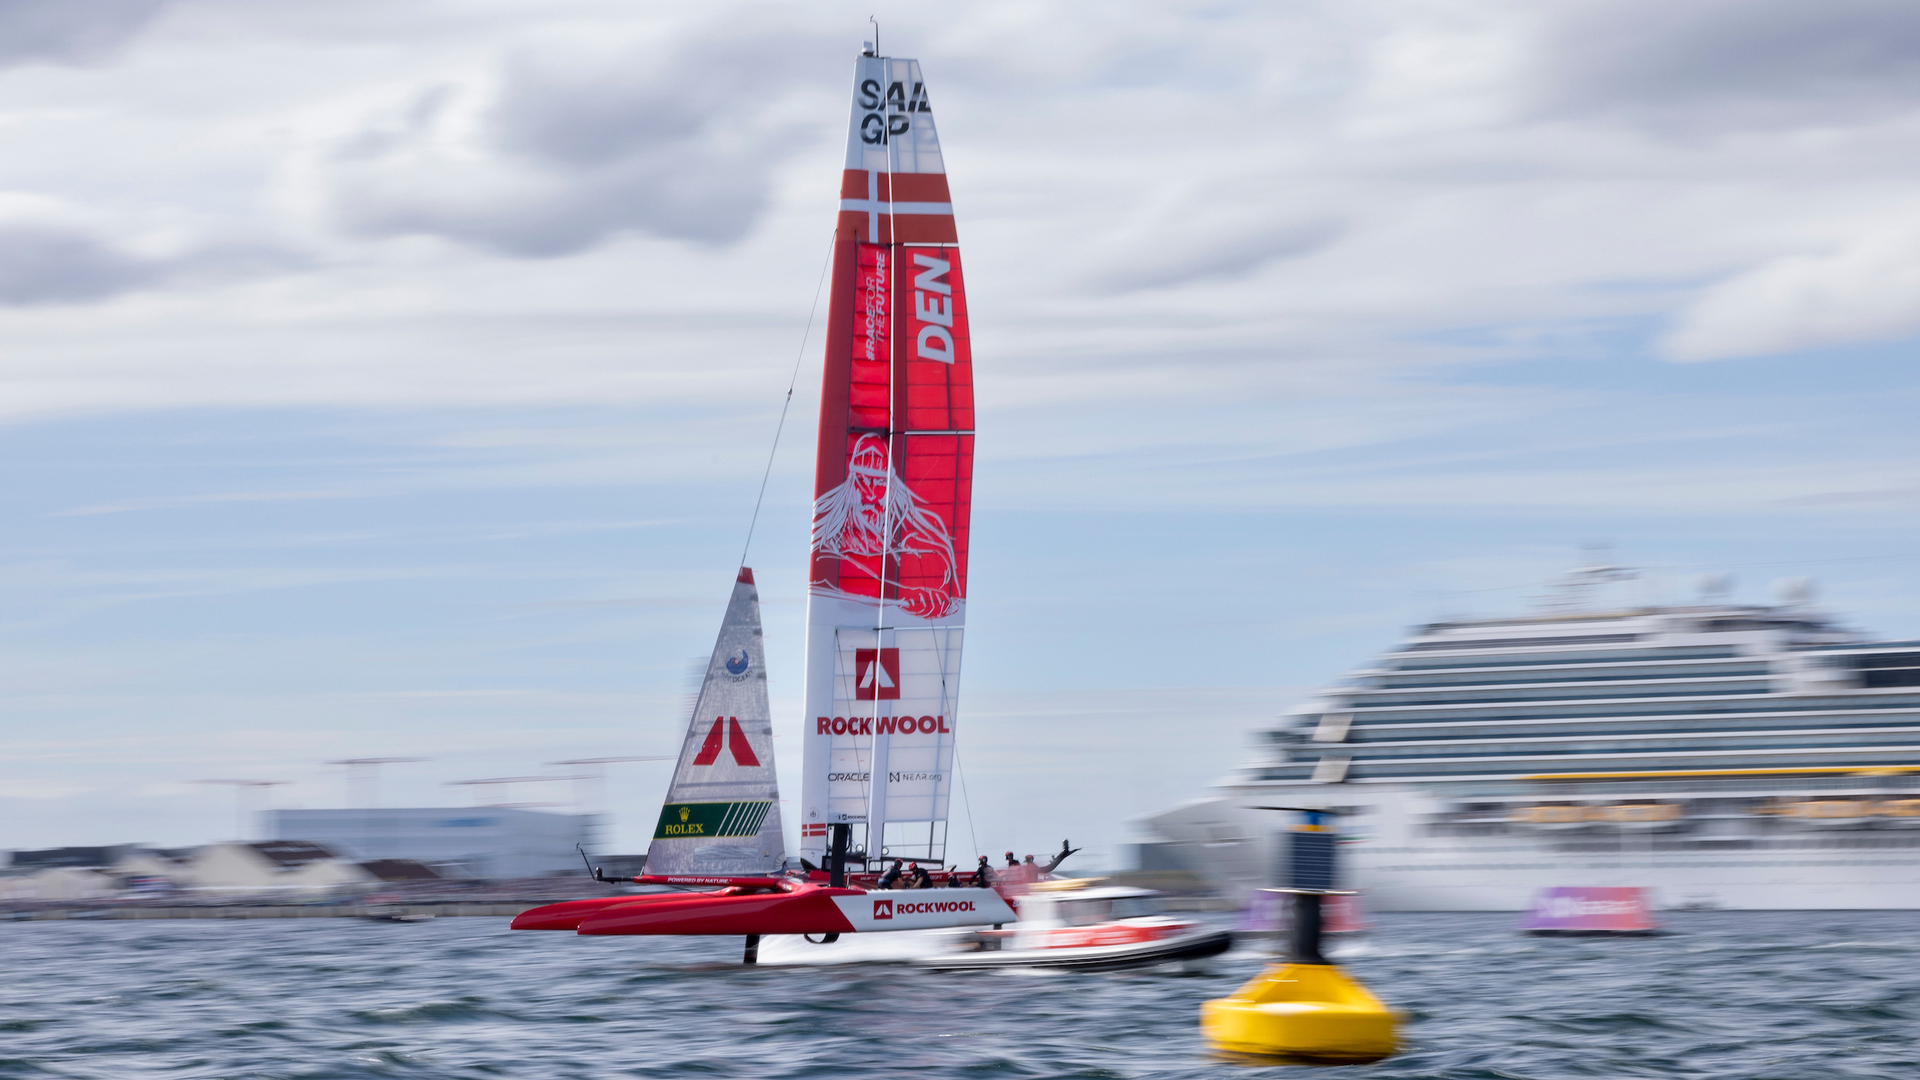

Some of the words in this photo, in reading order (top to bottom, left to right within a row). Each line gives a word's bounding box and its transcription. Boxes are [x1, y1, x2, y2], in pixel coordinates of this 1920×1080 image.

[858, 79, 932, 112] SAIL
[860, 113, 910, 146] GP
[913, 253, 955, 365] DEN
[817, 715, 950, 736] ROCKWOOL
[827, 773, 870, 782] ORACLE
[665, 823, 704, 835] ROLEX
[896, 901, 976, 914] ROCKWOOL
